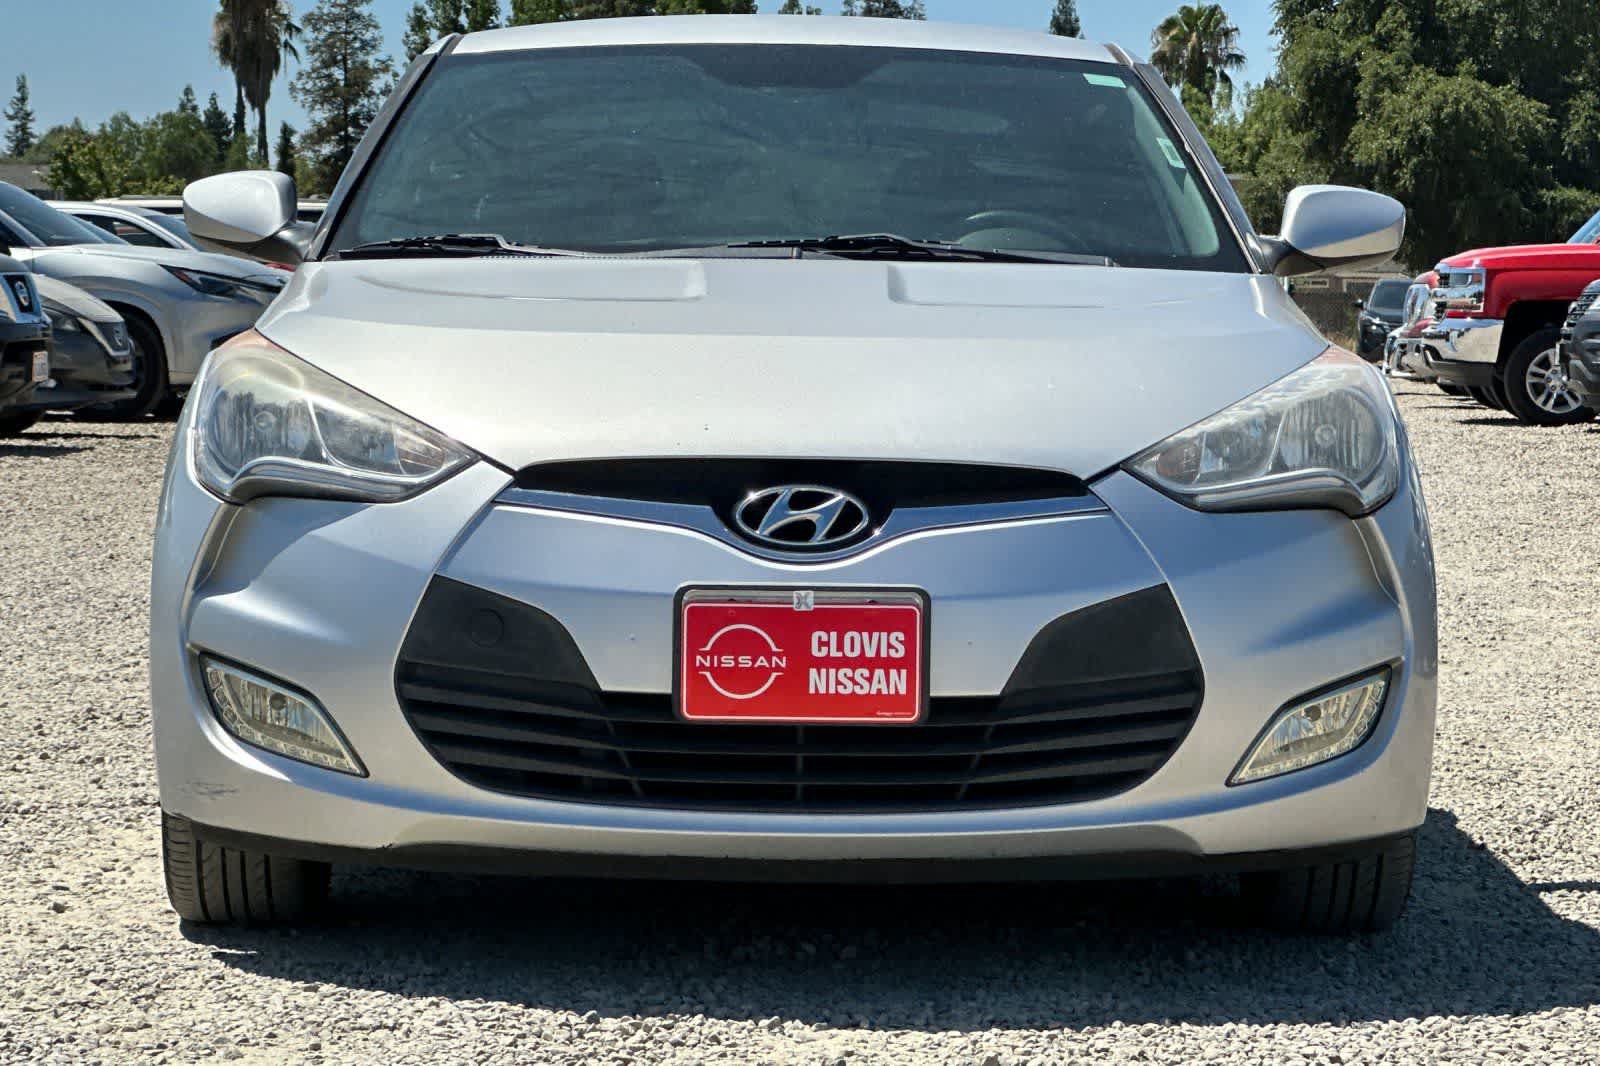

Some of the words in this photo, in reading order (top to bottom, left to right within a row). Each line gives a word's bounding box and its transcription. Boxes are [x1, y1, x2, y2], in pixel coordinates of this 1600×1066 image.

[810, 630, 906, 659] CLOVIS
[695, 655, 787, 668] NISSAN
[807, 667, 907, 696] NISSAN
